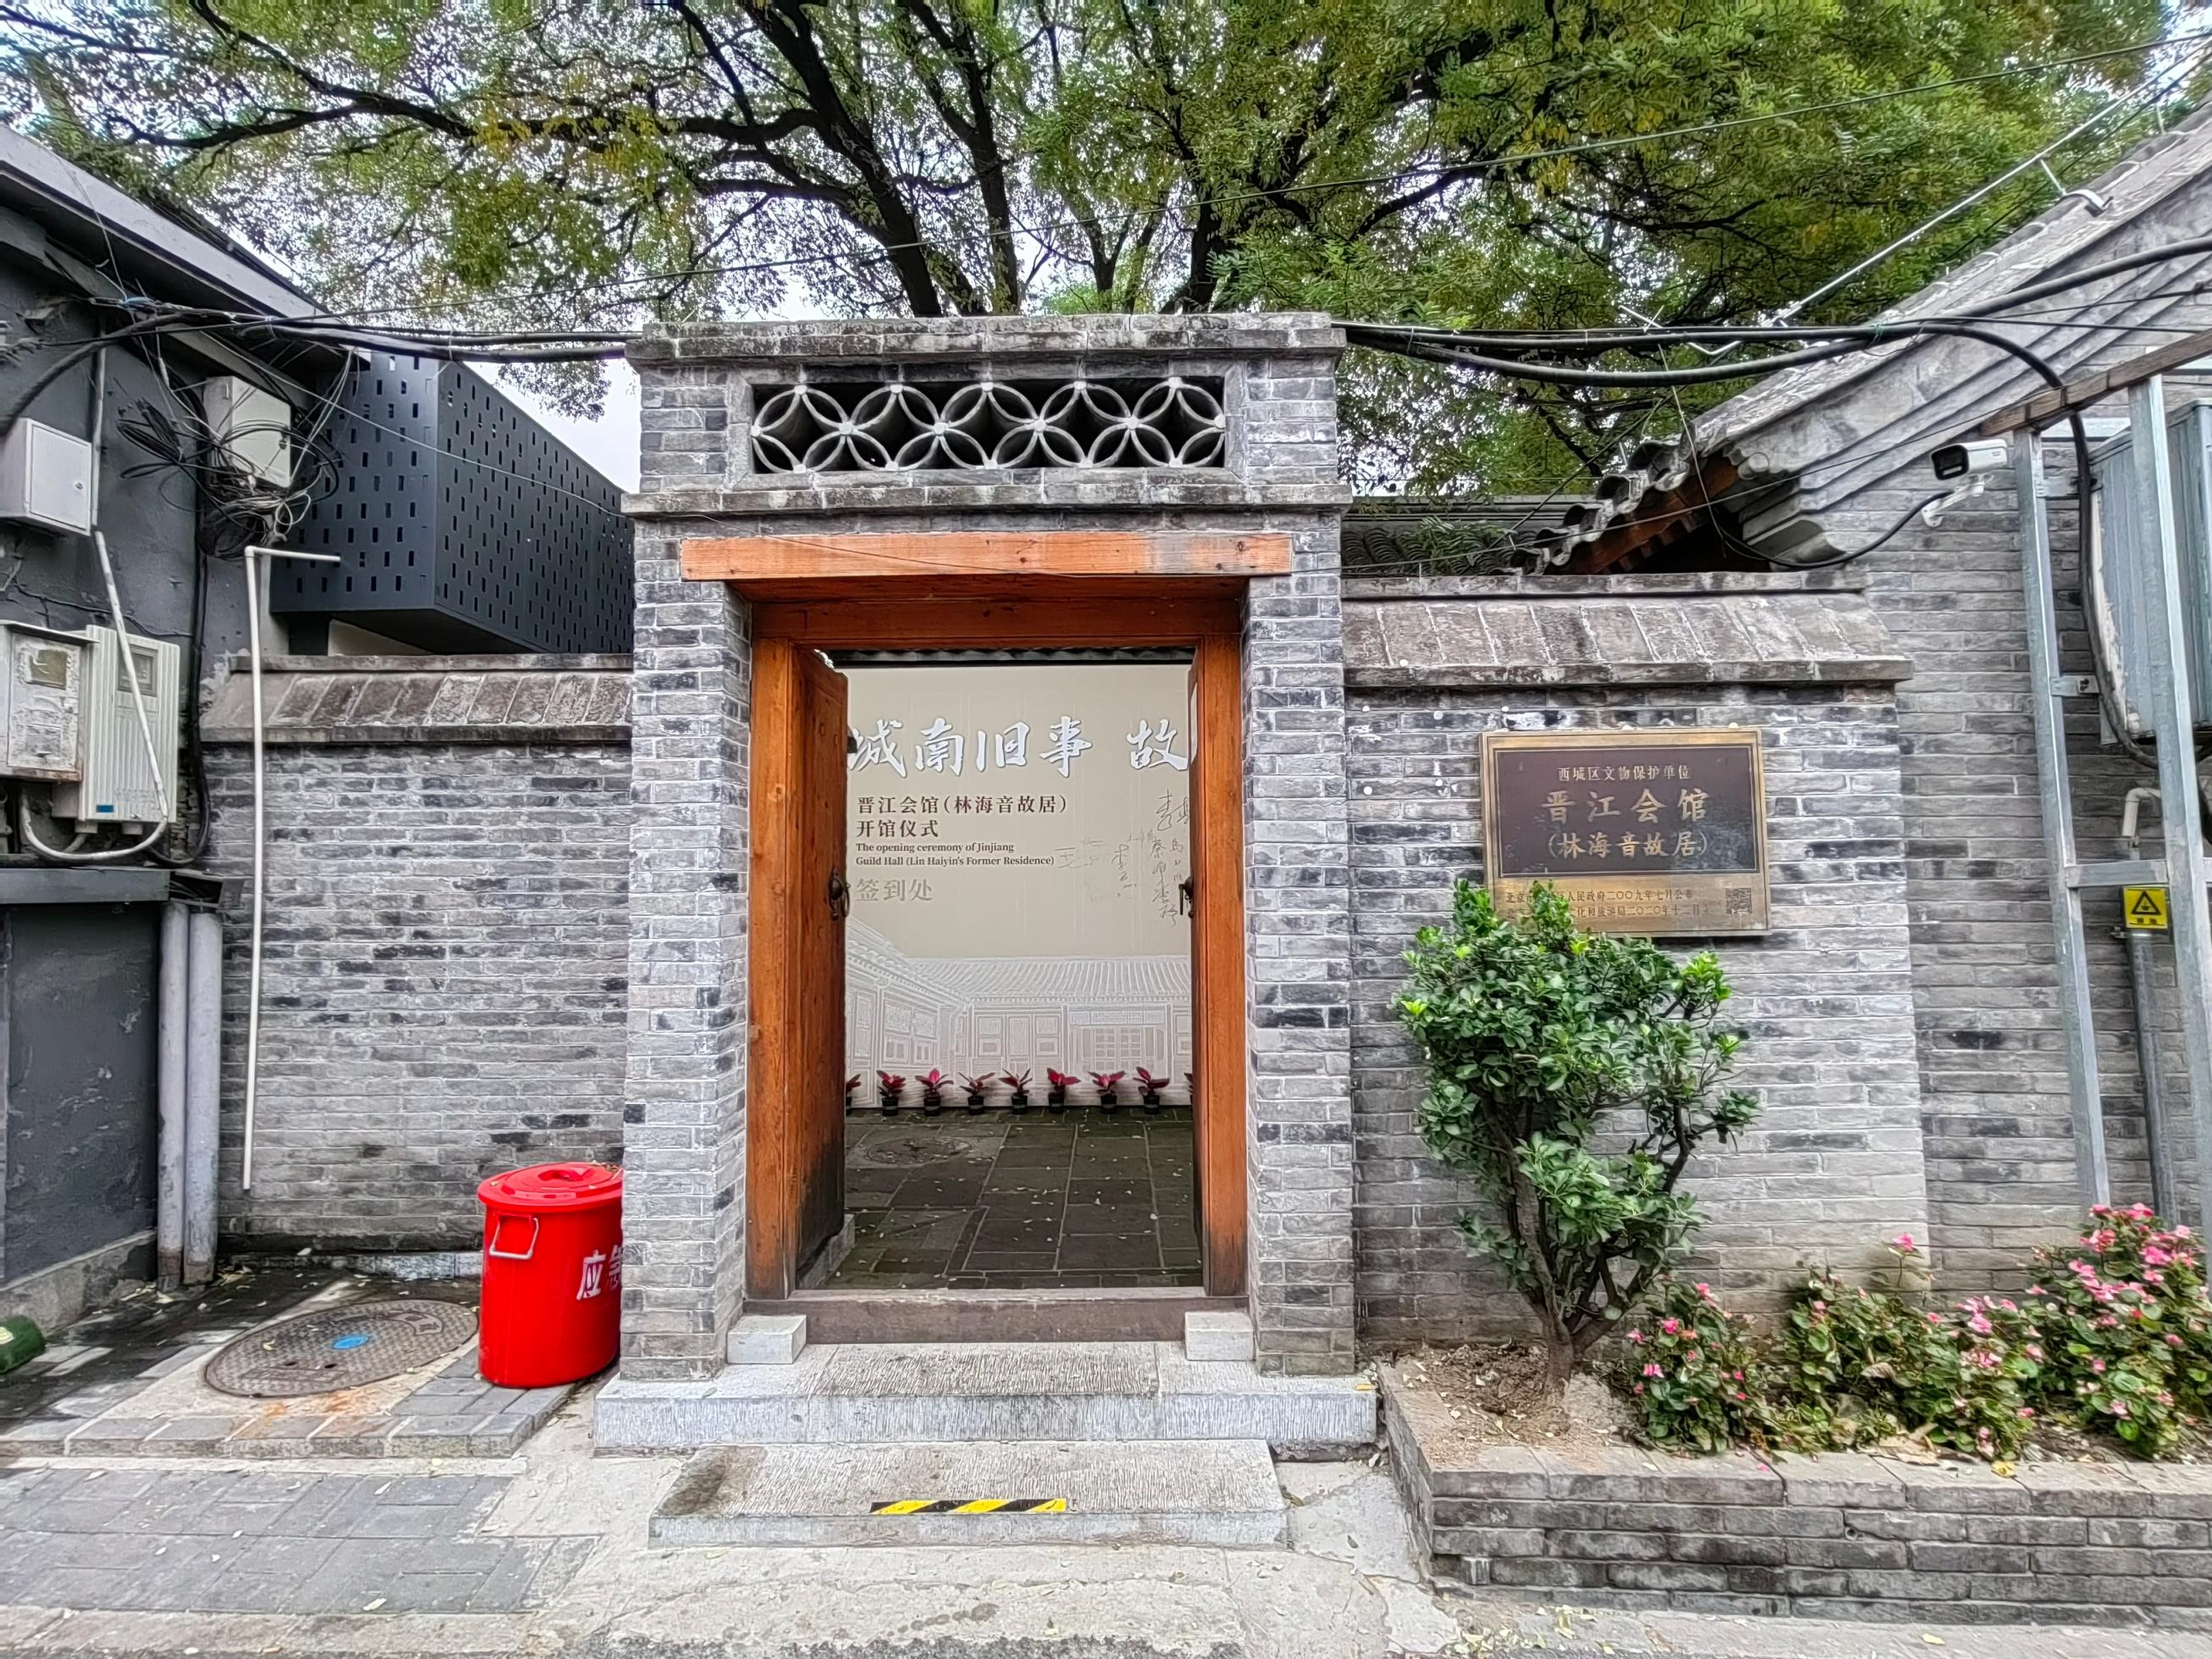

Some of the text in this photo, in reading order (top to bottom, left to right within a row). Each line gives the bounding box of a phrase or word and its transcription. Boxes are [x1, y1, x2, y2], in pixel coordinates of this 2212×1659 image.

[848, 715, 1189, 778] 城南旧事 故
[1557, 764, 1692, 782] 西城区文物保护单位
[857, 794, 1068, 815] 晋江会馆(林海音故居)
[1541, 787, 1710, 825] 晋江会馆
[856, 818, 940, 839] 开馆仪式
[856, 842, 1015, 854] The opening ceremony of Jinjiang
[856, 856, 1055, 868] Guild Hall (Lin Haiyin's Former Residence)
[854, 878, 934, 902] 签到处
